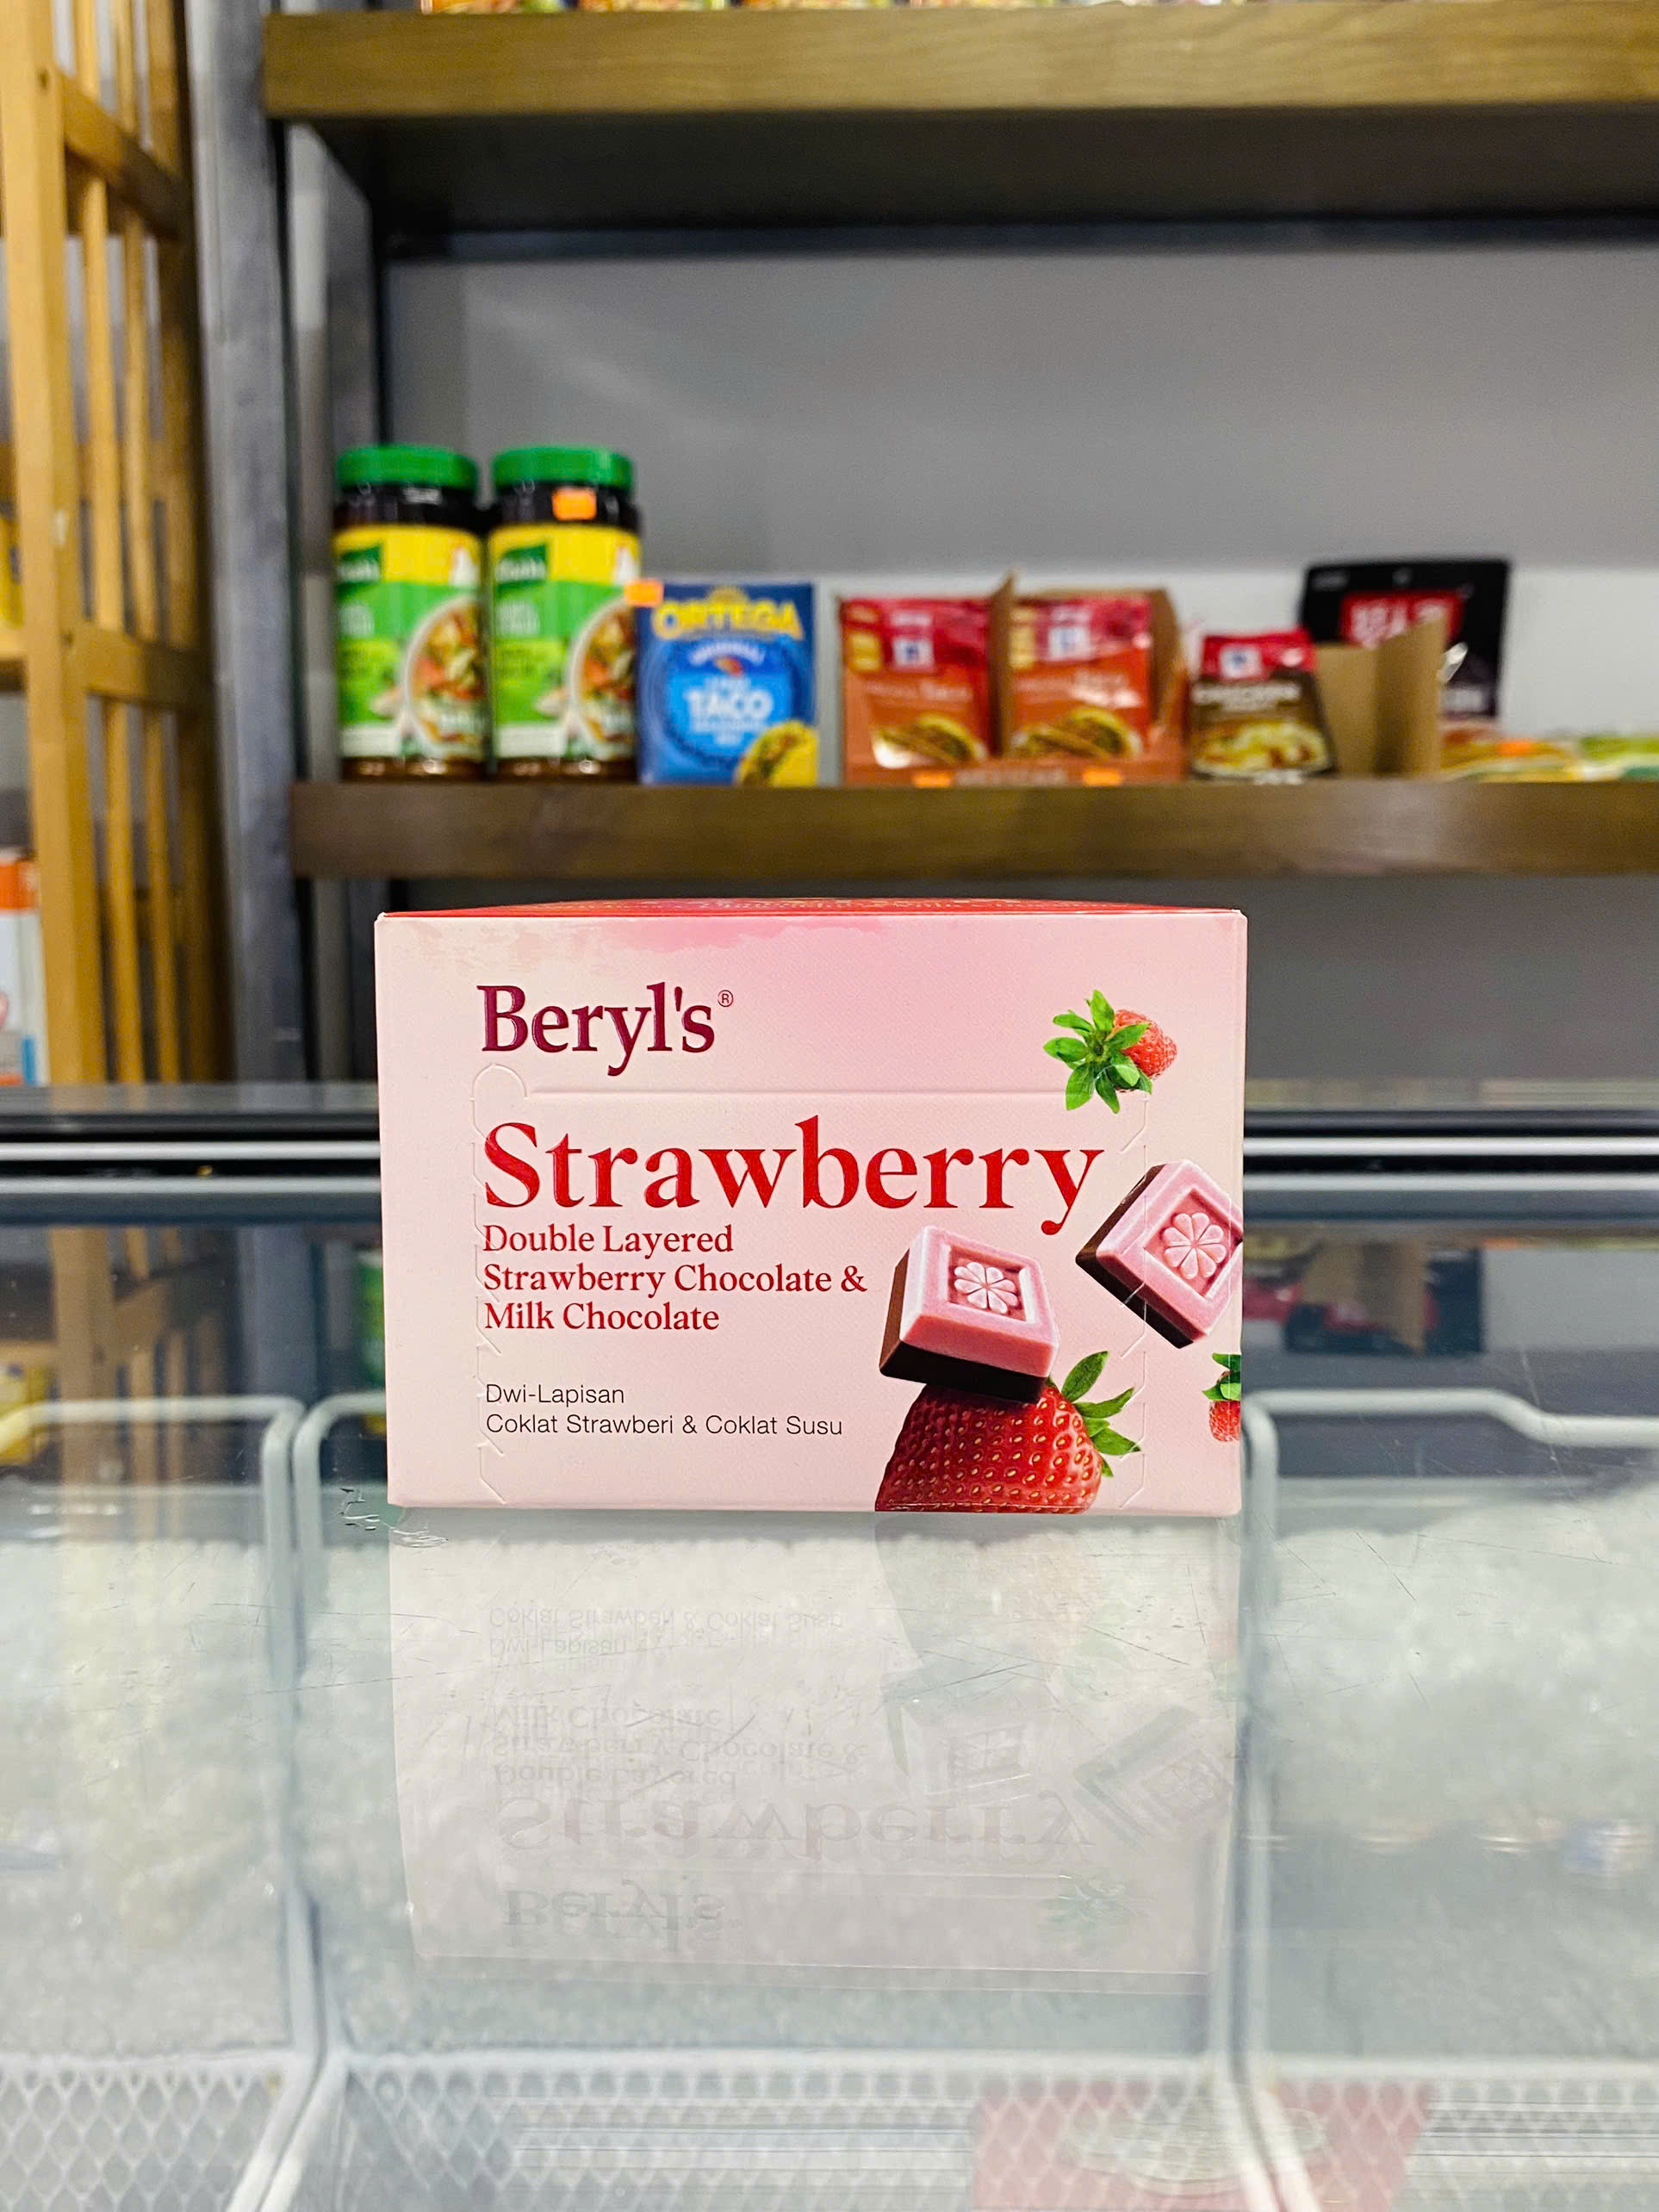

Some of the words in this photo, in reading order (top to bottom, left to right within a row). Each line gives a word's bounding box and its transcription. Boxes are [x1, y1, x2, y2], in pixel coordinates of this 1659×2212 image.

[483, 1115, 1105, 1236] Strawberry
[484, 1223, 594, 1252] Double
[602, 1224, 734, 1259] Layered
[484, 1263, 666, 1298] Strawberry
[674, 1263, 831, 1292] Chocolate
[841, 1265, 867, 1292] &
[484, 1301, 555, 1329] Milk
[563, 1302, 719, 1330] Chocolate
[486, 1383, 625, 1407] Dwi-Lapisan
[487, 1414, 558, 1433] Coklat
[567, 1414, 674, 1434] Strawberi
[681, 1414, 698, 1434] &
[706, 1414, 778, 1435] Coklat
[786, 1415, 842, 1435] Susu
